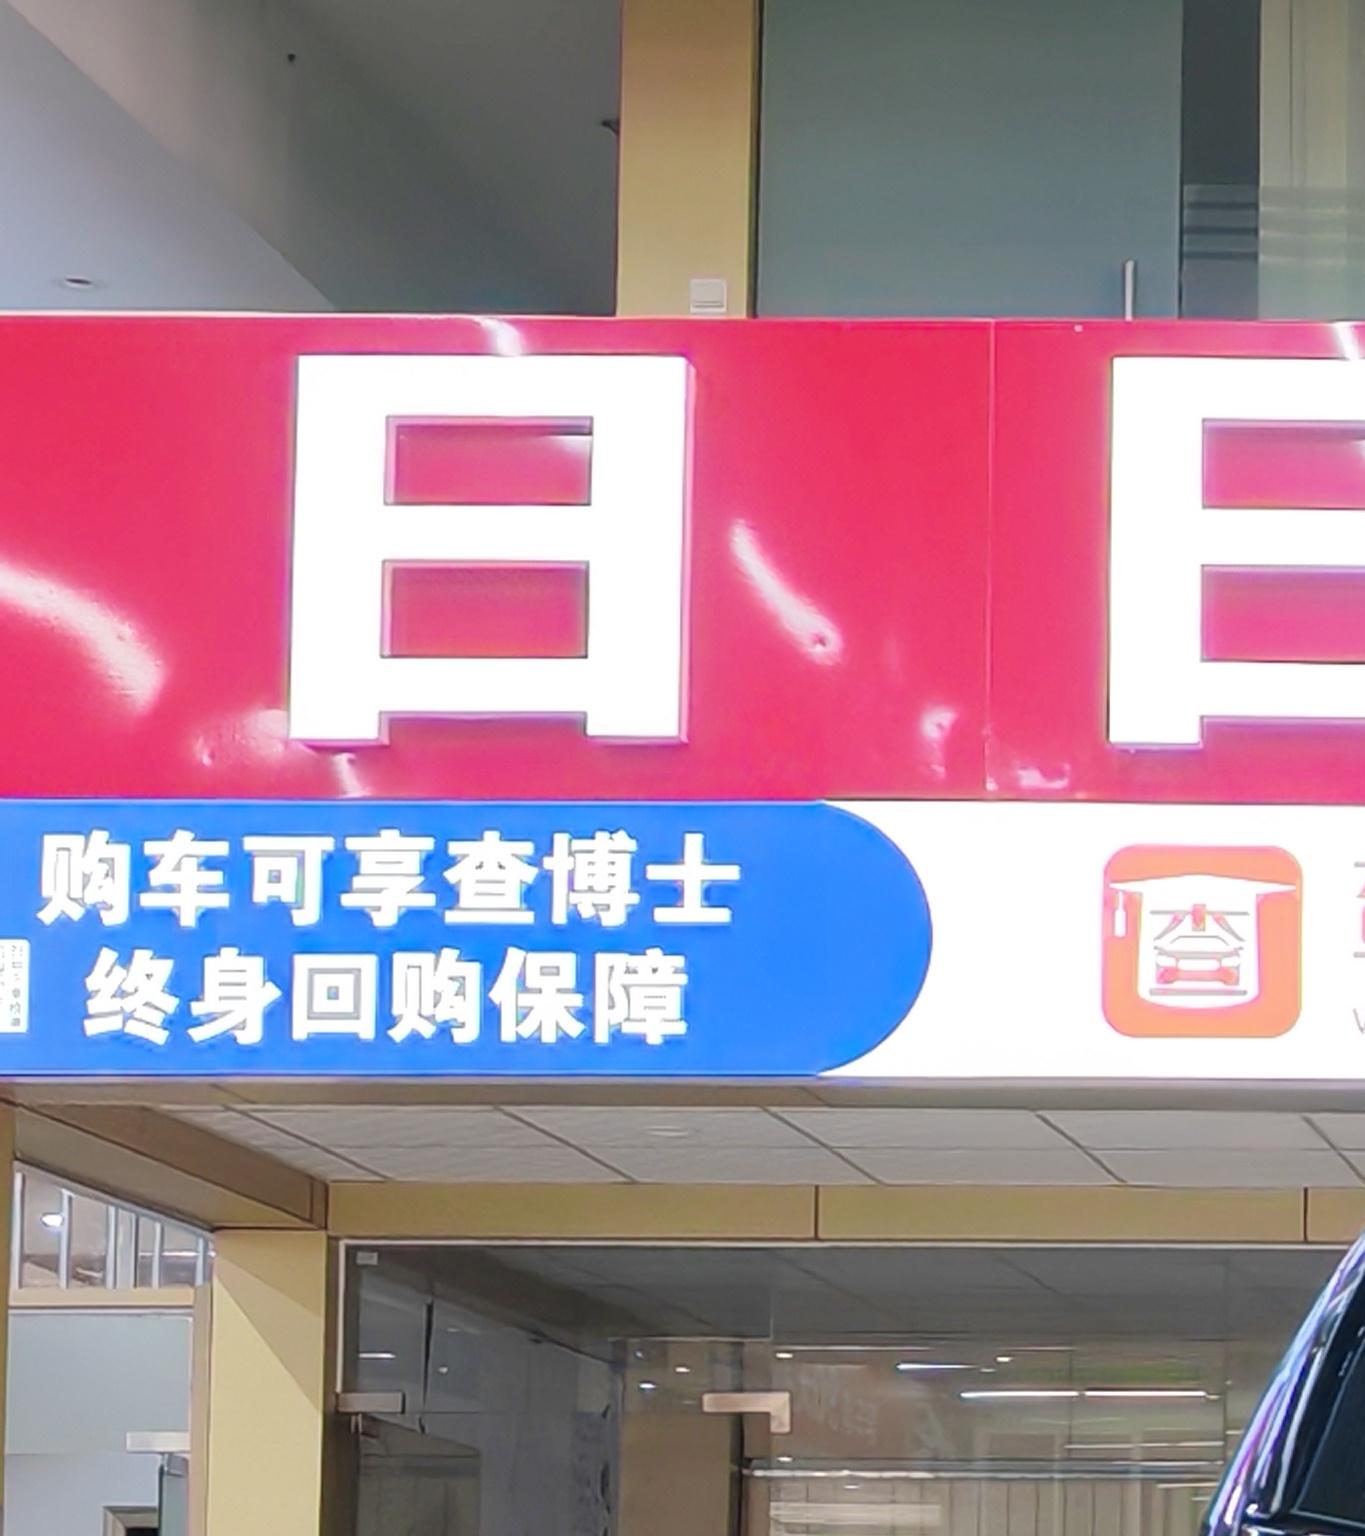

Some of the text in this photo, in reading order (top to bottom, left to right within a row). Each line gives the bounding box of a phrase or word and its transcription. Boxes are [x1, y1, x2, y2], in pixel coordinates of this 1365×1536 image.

[37, 829, 742, 926] 购车可享查博士
[82, 946, 690, 1046] 终身回购保障
